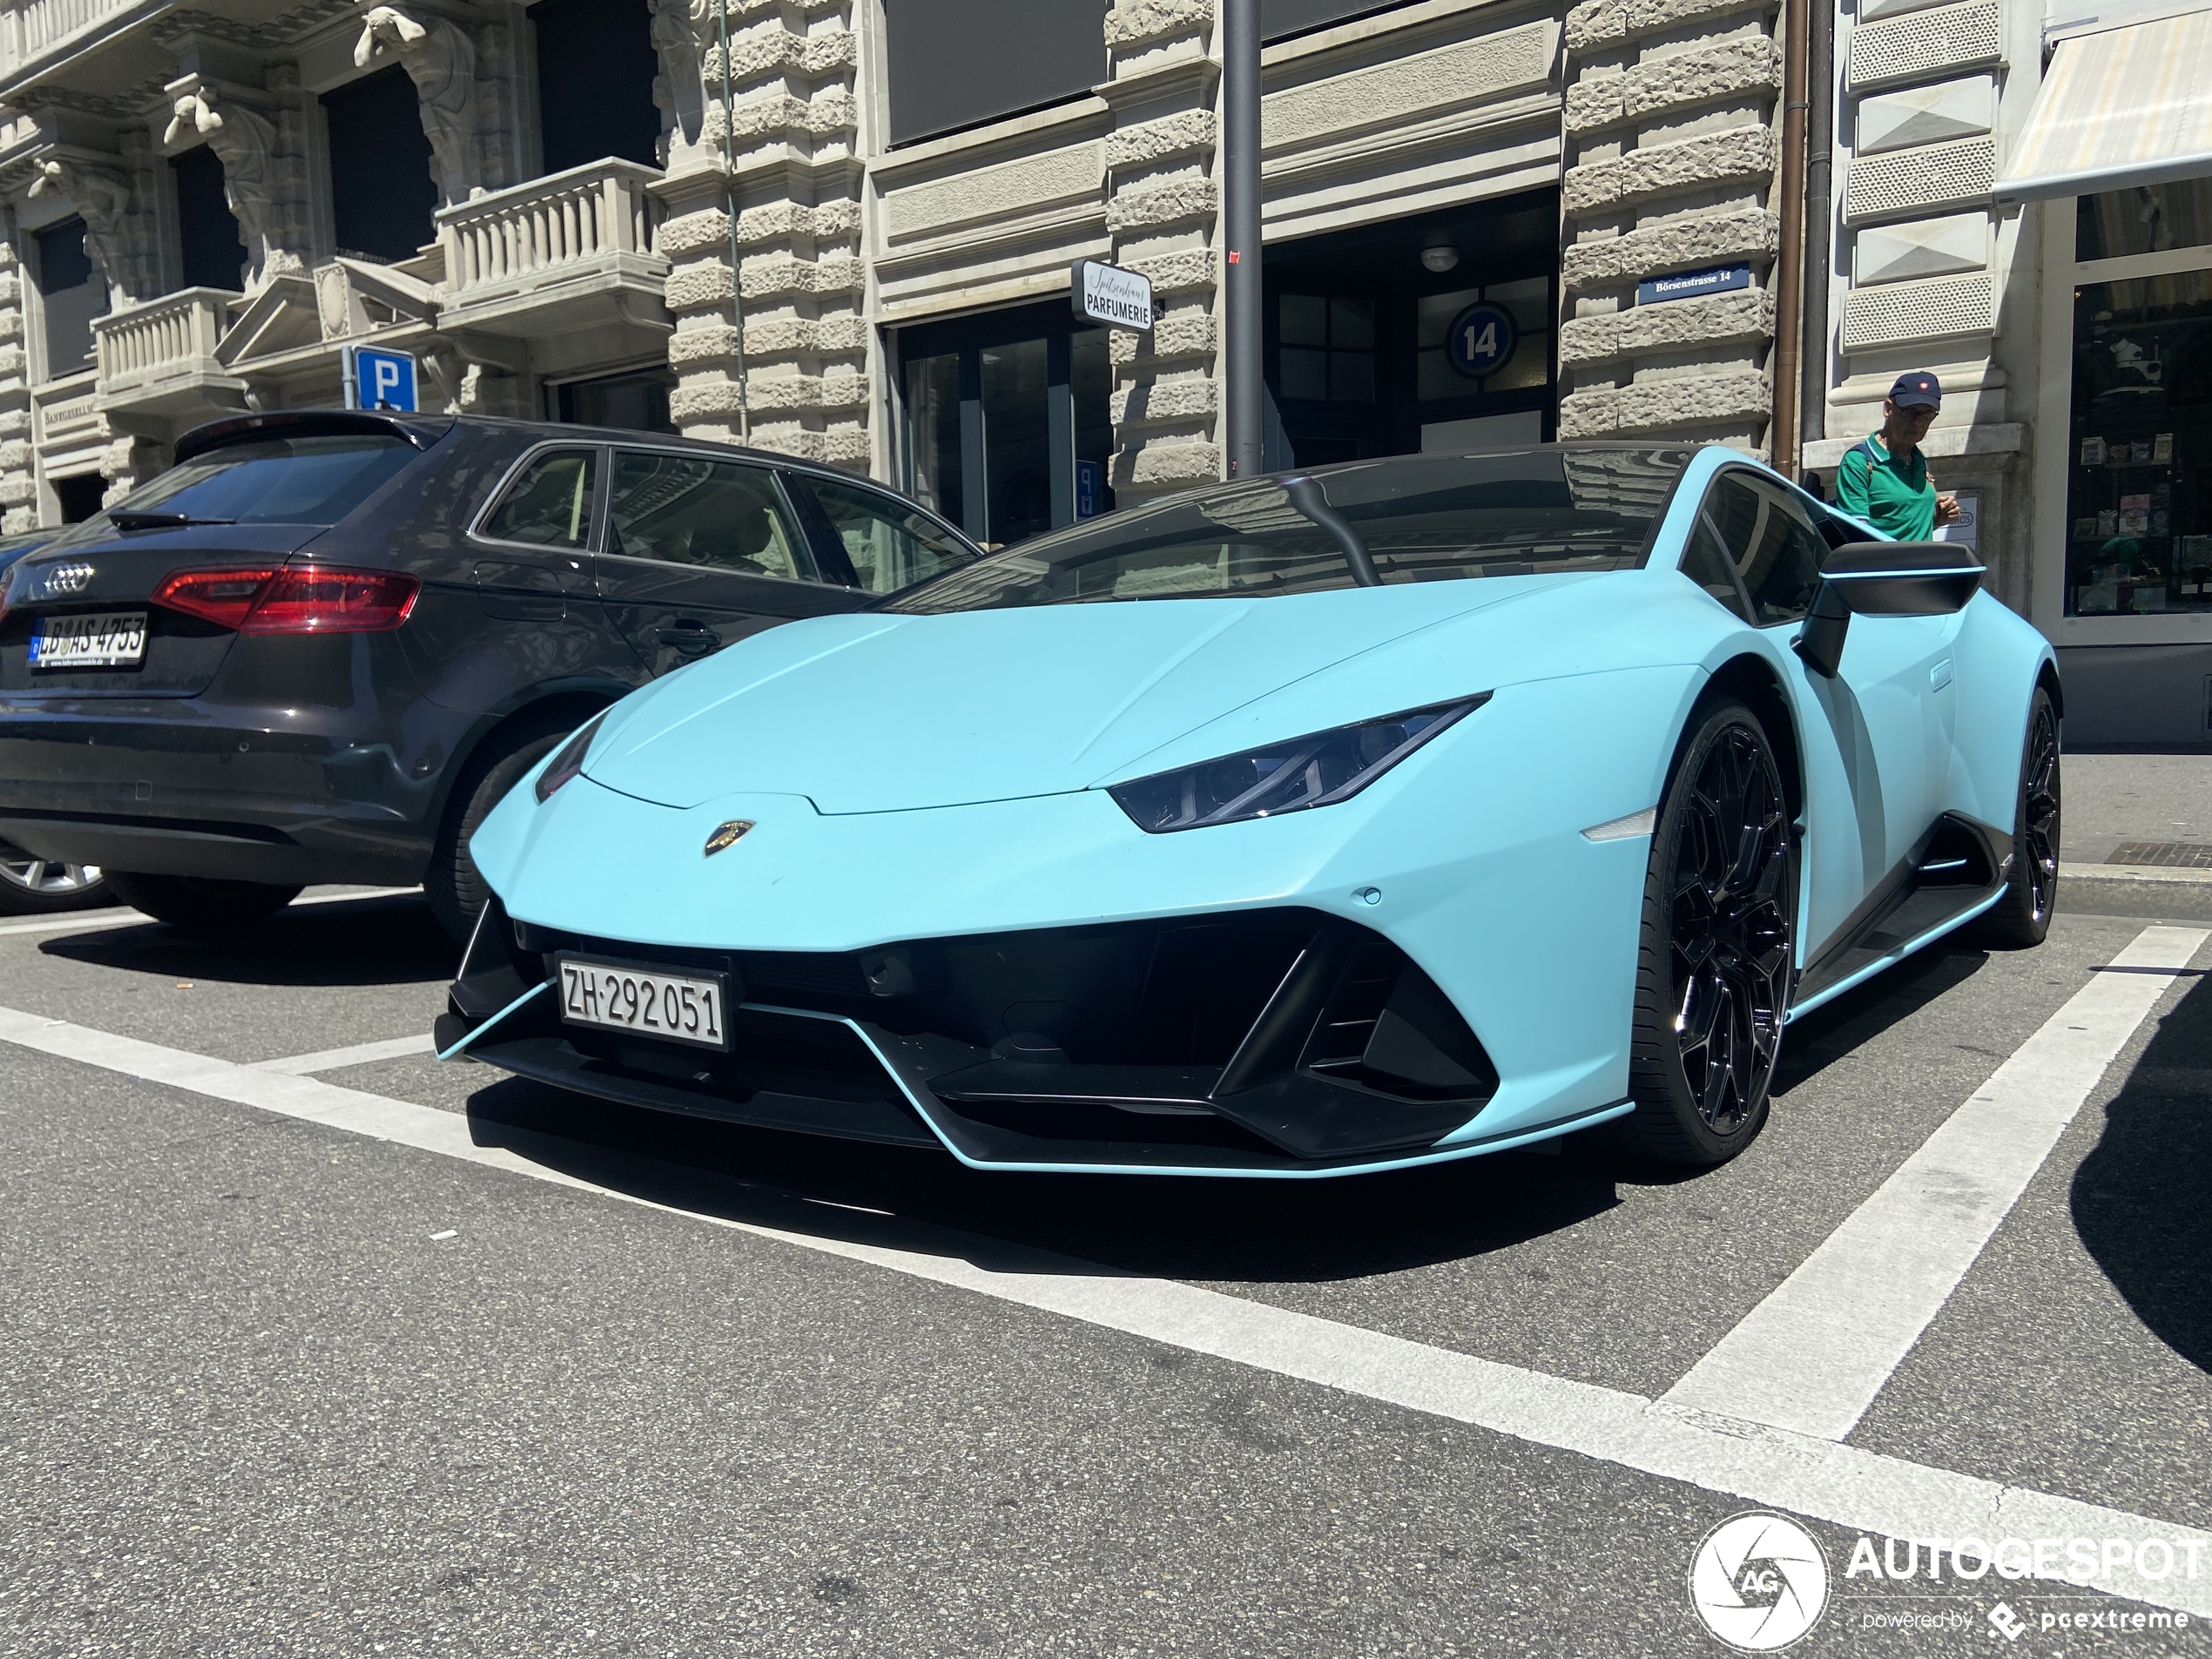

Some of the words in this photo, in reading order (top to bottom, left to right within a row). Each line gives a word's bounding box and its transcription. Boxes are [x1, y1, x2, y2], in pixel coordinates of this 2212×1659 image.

[1090, 267, 1144, 301] Spitzenhaus
[1656, 275, 1716, 293] Börsenstrasse
[1720, 271, 1730, 282] 14
[1087, 293, 1148, 324] PARFUMERIE
[1464, 322, 1496, 360] 14
[374, 359, 399, 399] P
[44, 404, 93, 425] BANKGESELLSC
[40, 621, 62, 654] LB
[70, 619, 96, 653] AS
[97, 617, 145, 652] 4753
